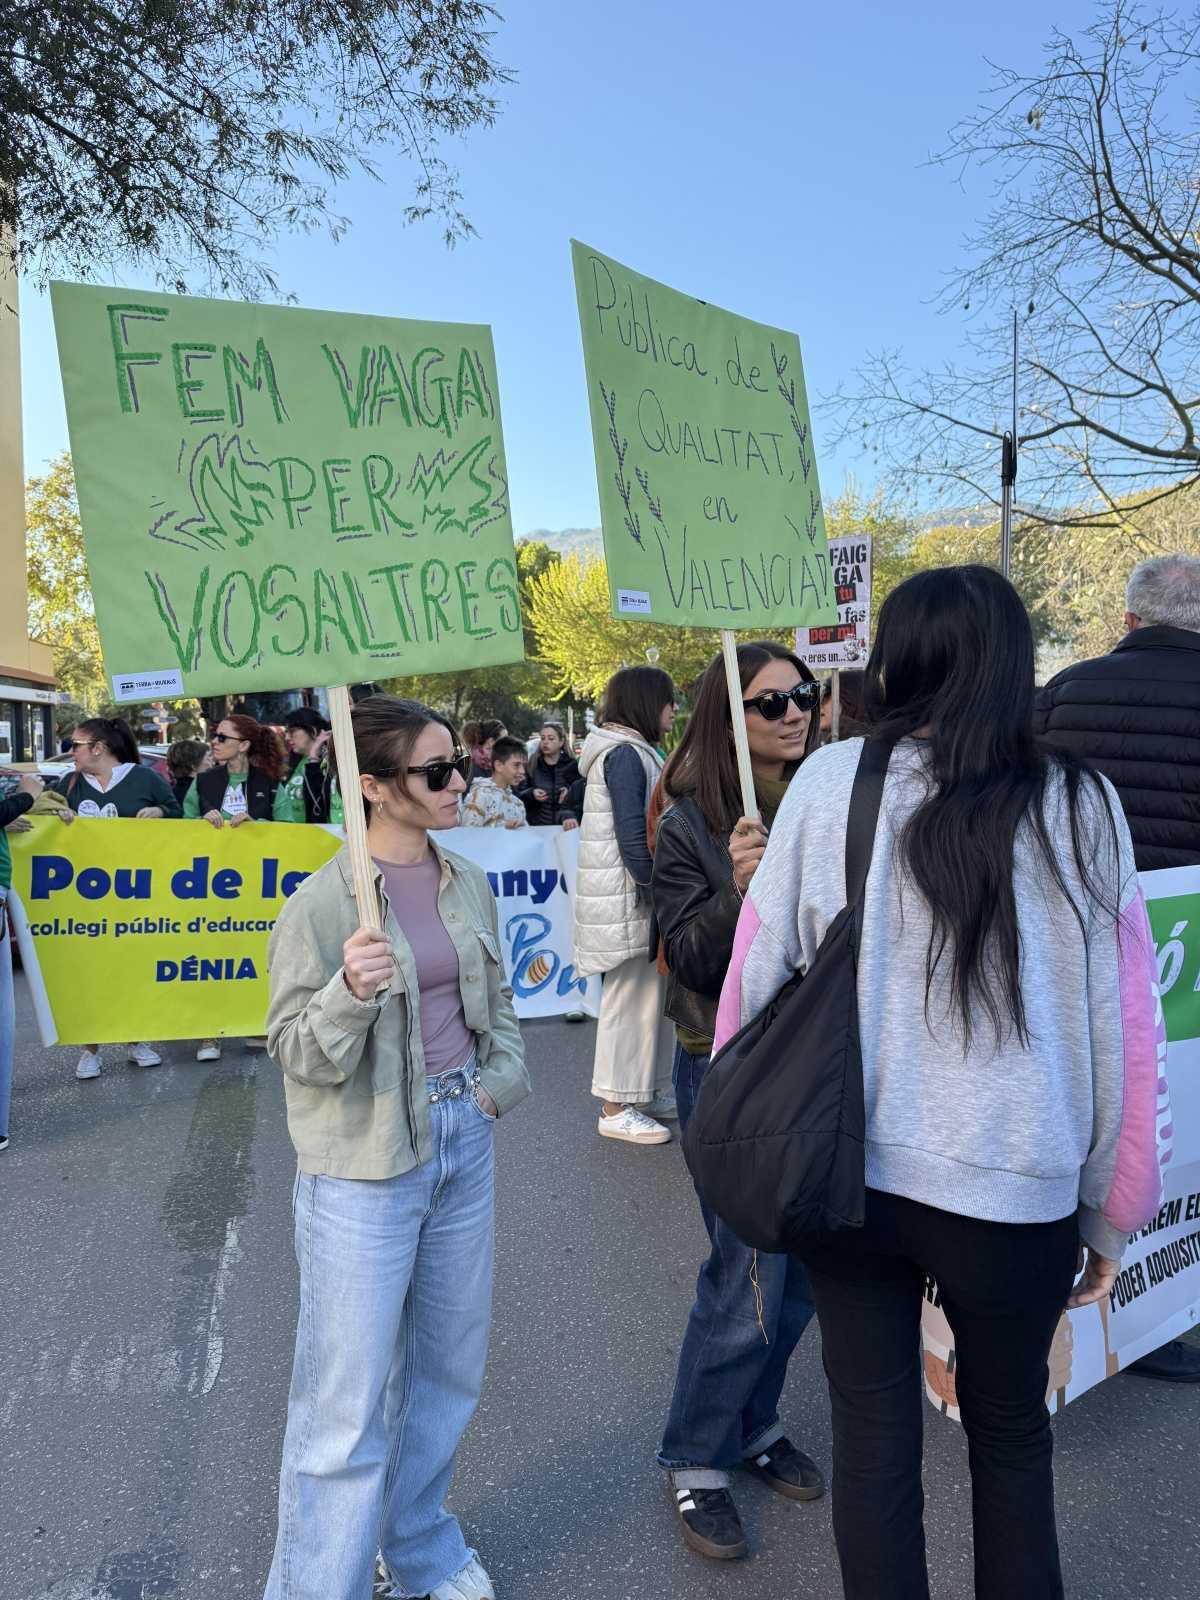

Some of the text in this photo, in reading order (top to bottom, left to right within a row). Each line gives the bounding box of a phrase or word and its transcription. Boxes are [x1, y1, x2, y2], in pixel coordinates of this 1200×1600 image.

[107, 303, 495, 438] FEM VAGA
[727, 336, 768, 393] de
[704, 495, 738, 523] en
[830, 544, 867, 566] FAIG
[839, 587, 854, 600] tu
[144, 557, 521, 673] VOSALTRES
[845, 607, 867, 623] fas
[810, 628, 833, 645] per
[31, 856, 152, 899] Pou
[171, 857, 243, 899] de
[115, 917, 181, 937] públic
[156, 955, 258, 982] DÉNIA
[1109, 1262, 1147, 1313] PODER
